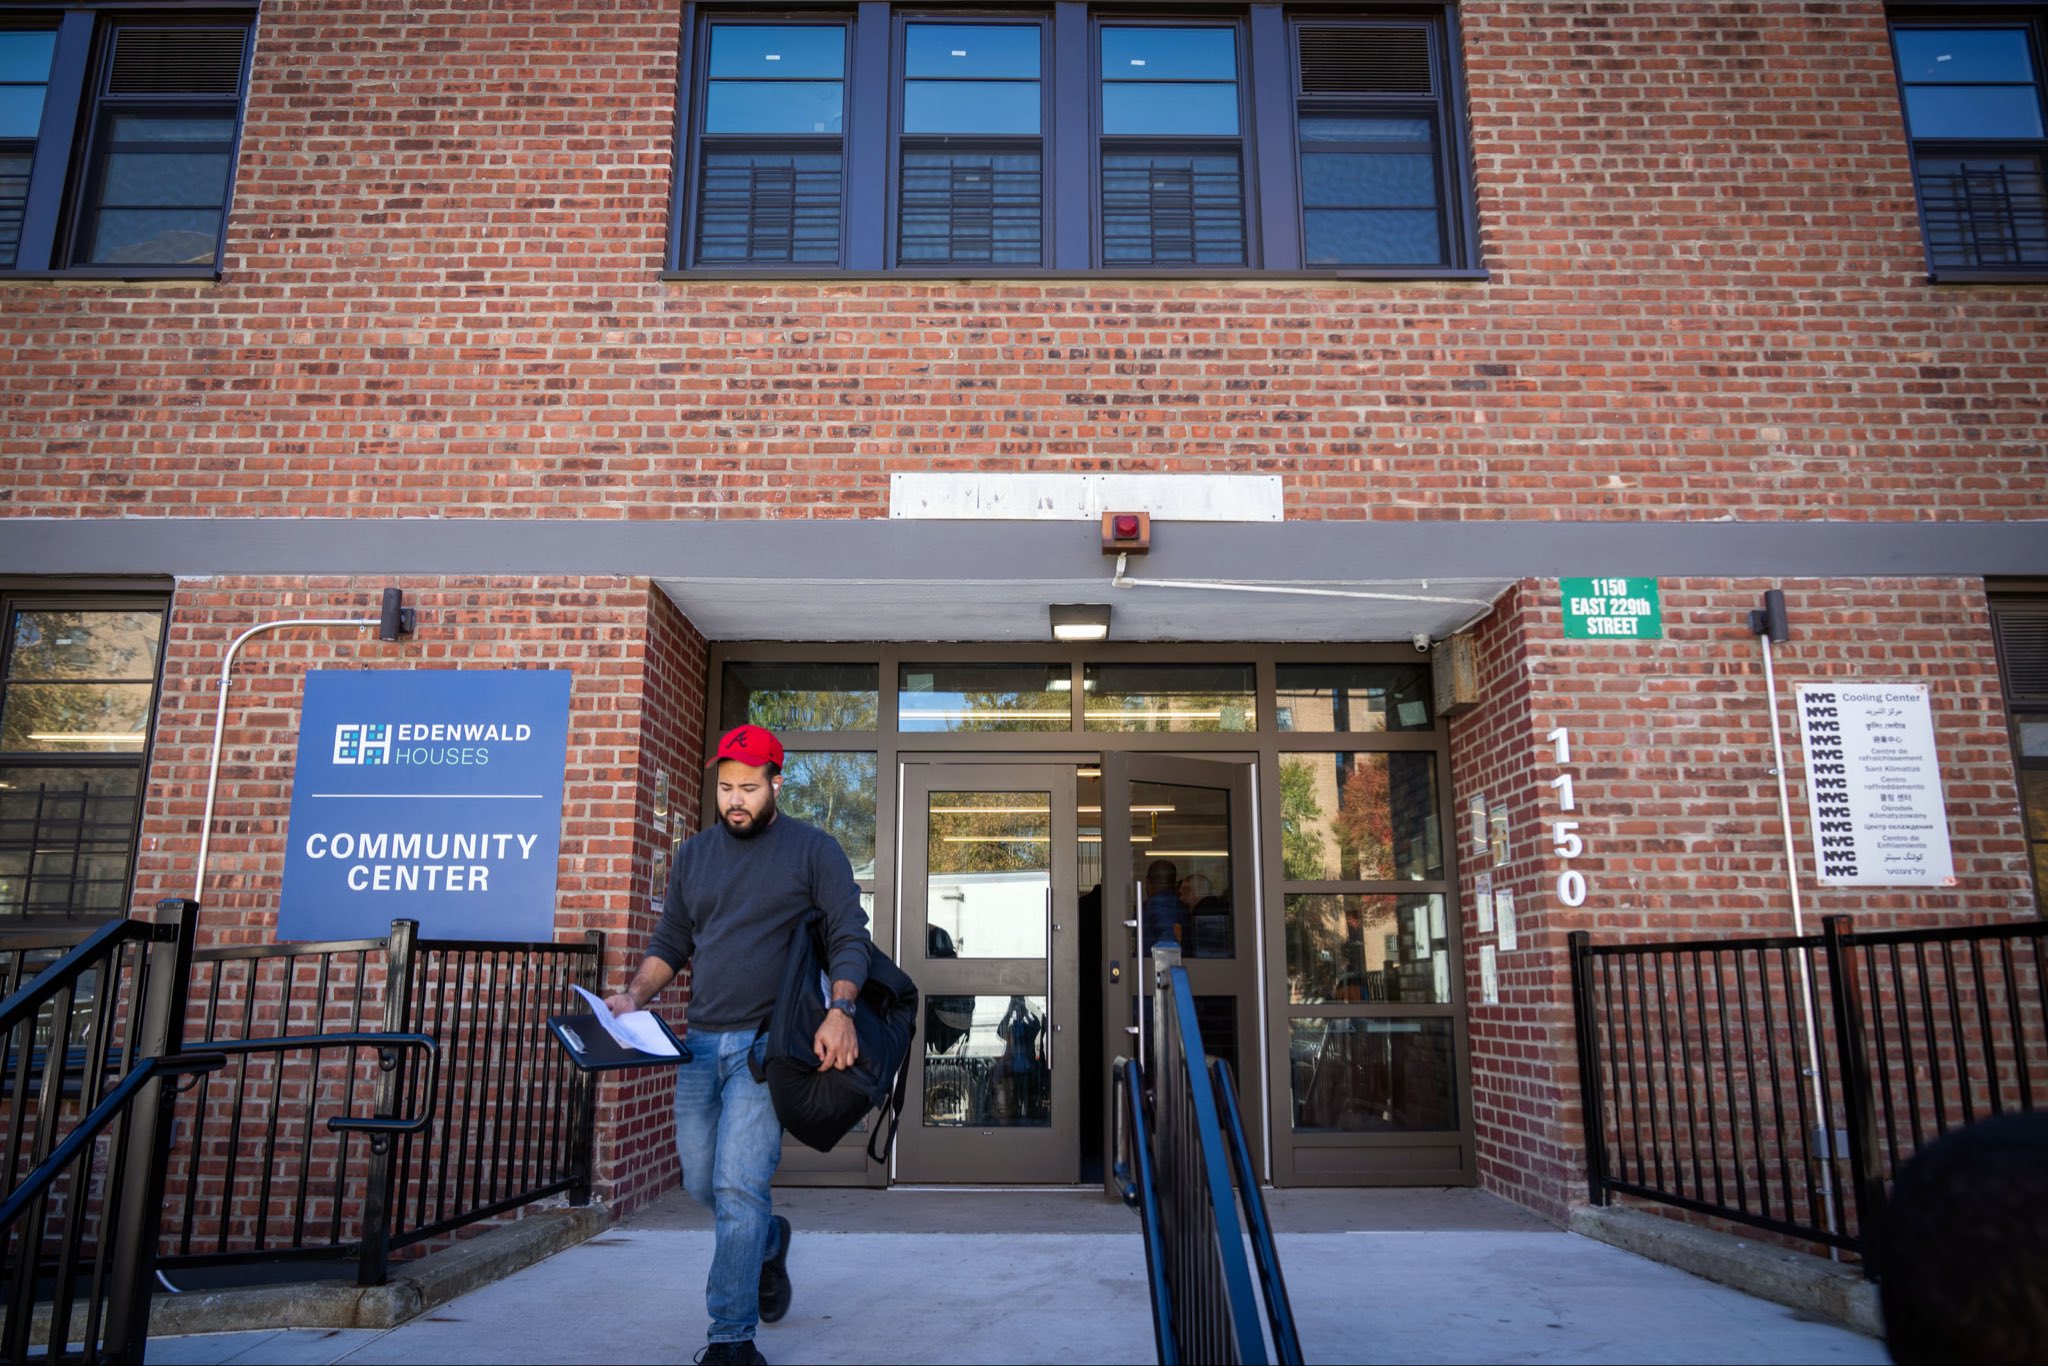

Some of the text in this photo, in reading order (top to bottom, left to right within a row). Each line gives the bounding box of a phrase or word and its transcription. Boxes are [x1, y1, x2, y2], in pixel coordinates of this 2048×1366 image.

[1592, 579, 1627, 596] 1150
[1571, 598, 1651, 615] EAST 229th
[1587, 617, 1638, 635] STREET
[1805, 693, 1836, 703] NYC
[1842, 693, 1920, 703] Cooling Center
[1807, 707, 1838, 717] NYC
[1809, 721, 1840, 731] NYC
[398, 724, 531, 741] EDENWALD
[1810, 735, 1842, 745] NYC
[395, 748, 489, 765] HOUSES
[1812, 749, 1844, 759] NYC
[1814, 763, 1846, 774] NYC
[1816, 778, 1847, 788] NYC
[1817, 792, 1849, 803] NYC
[1819, 806, 1851, 817] NYC
[1821, 821, 1853, 832] NYC
[305, 833, 538, 860] COMMUNITY
[1822, 836, 1855, 846] NYC
[1824, 850, 1857, 861] NYC
[1825, 865, 1859, 876] NYC
[347, 865, 490, 891] CENTER
